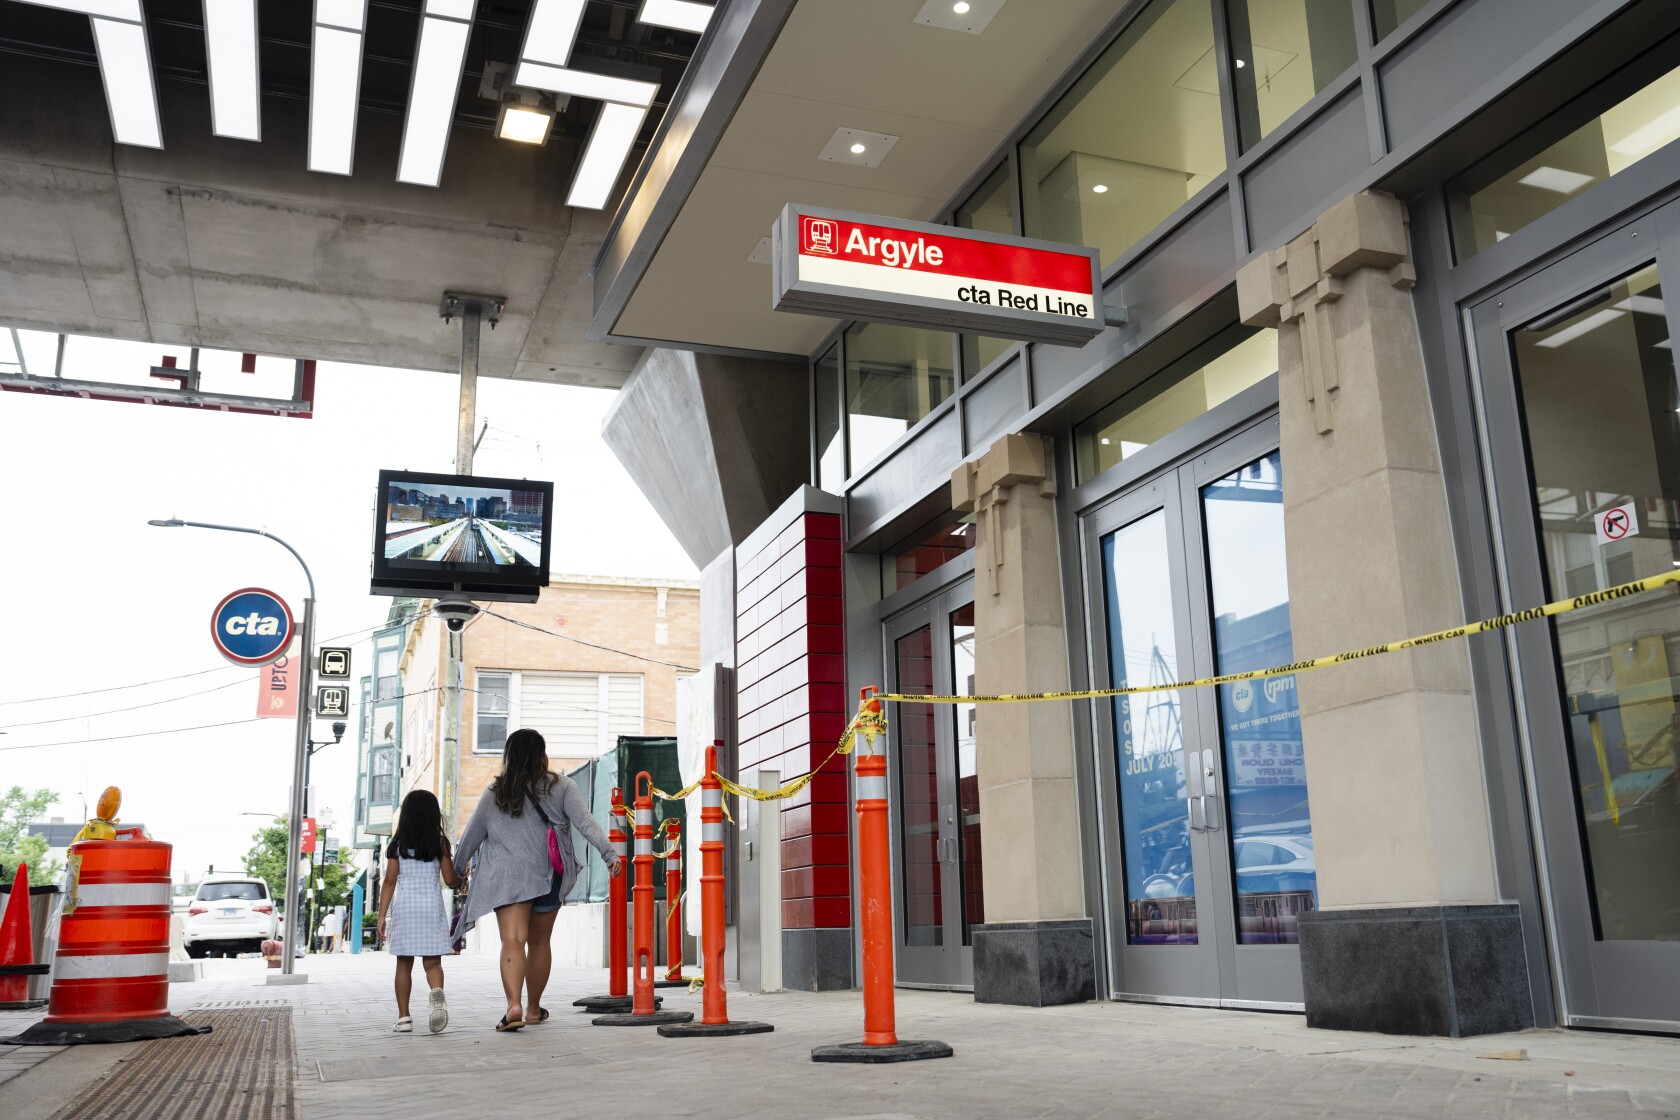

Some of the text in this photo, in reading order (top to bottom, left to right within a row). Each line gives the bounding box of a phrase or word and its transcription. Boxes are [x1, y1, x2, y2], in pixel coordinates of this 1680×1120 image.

[845, 228, 943, 268] Argyle
[957, 285, 1088, 317] cta Red Line
[225, 612, 279, 636] cta
[1250, 716, 1269, 727] THERE
[1126, 750, 1177, 776] JULY 20!
